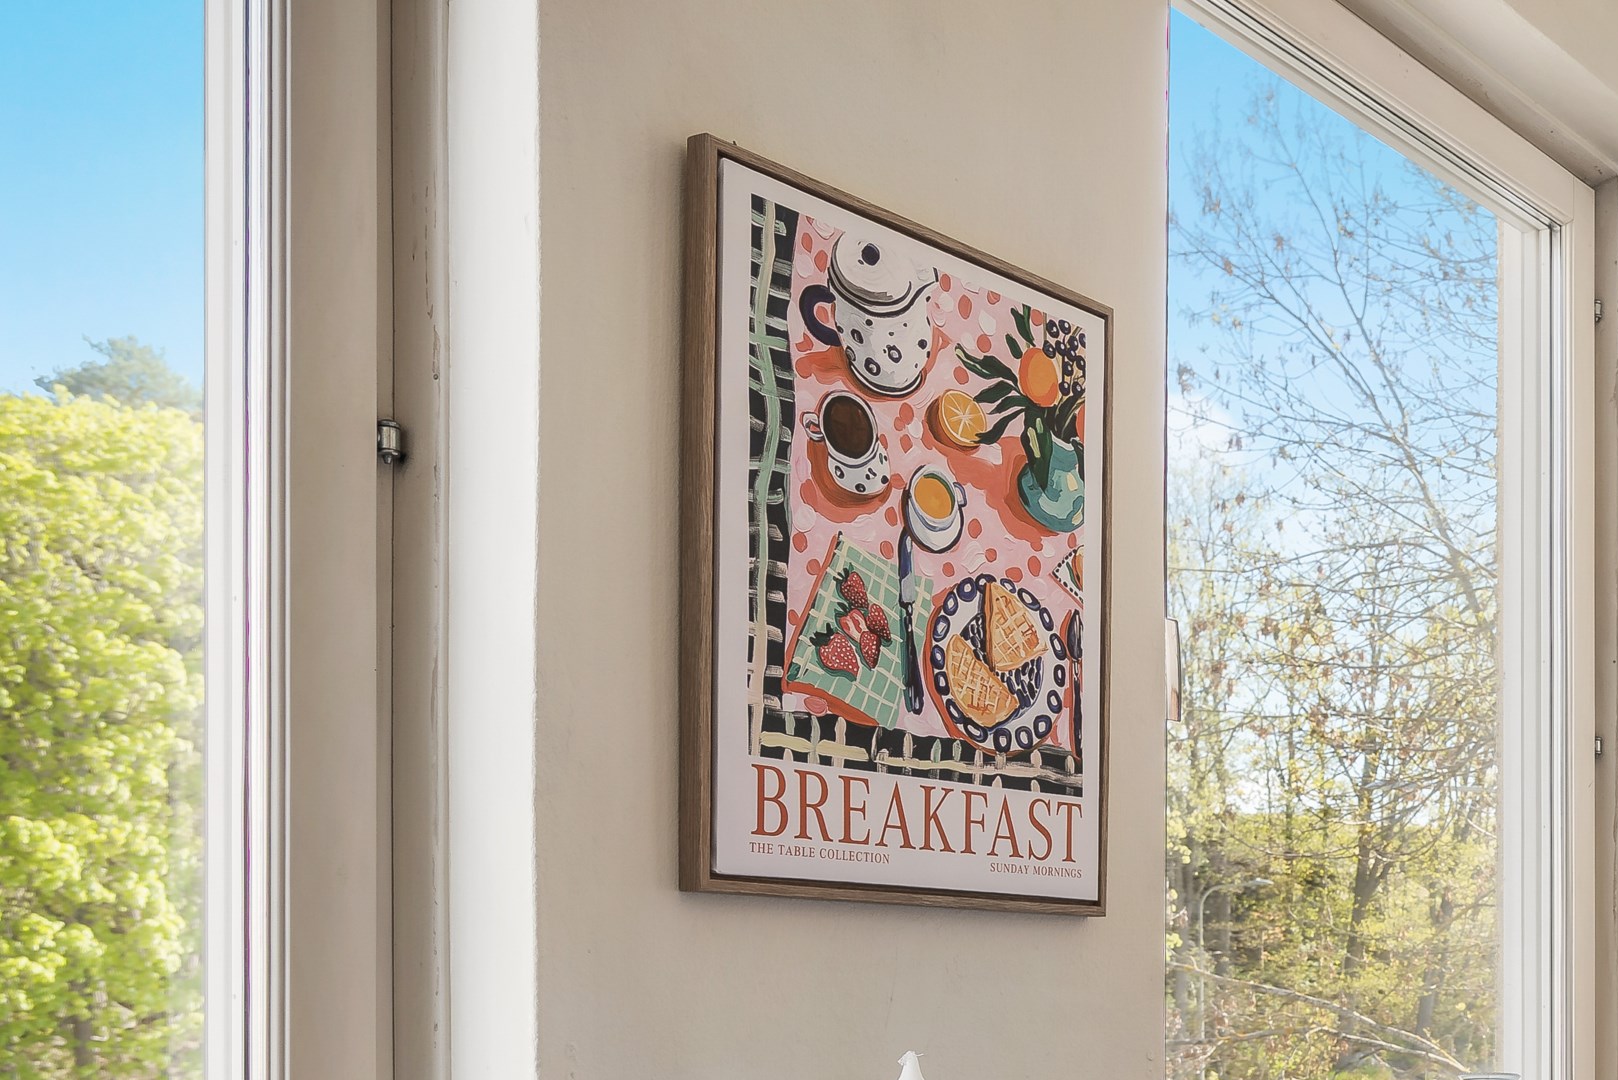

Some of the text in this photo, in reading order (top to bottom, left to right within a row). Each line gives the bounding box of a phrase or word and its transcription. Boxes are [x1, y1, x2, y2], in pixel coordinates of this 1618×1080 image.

[751, 763, 1083, 863] BREAKFAST
[749, 842, 890, 864] THE TABLE COLLECTION
[990, 862, 1082, 879] SUNDAY MORNINGS
